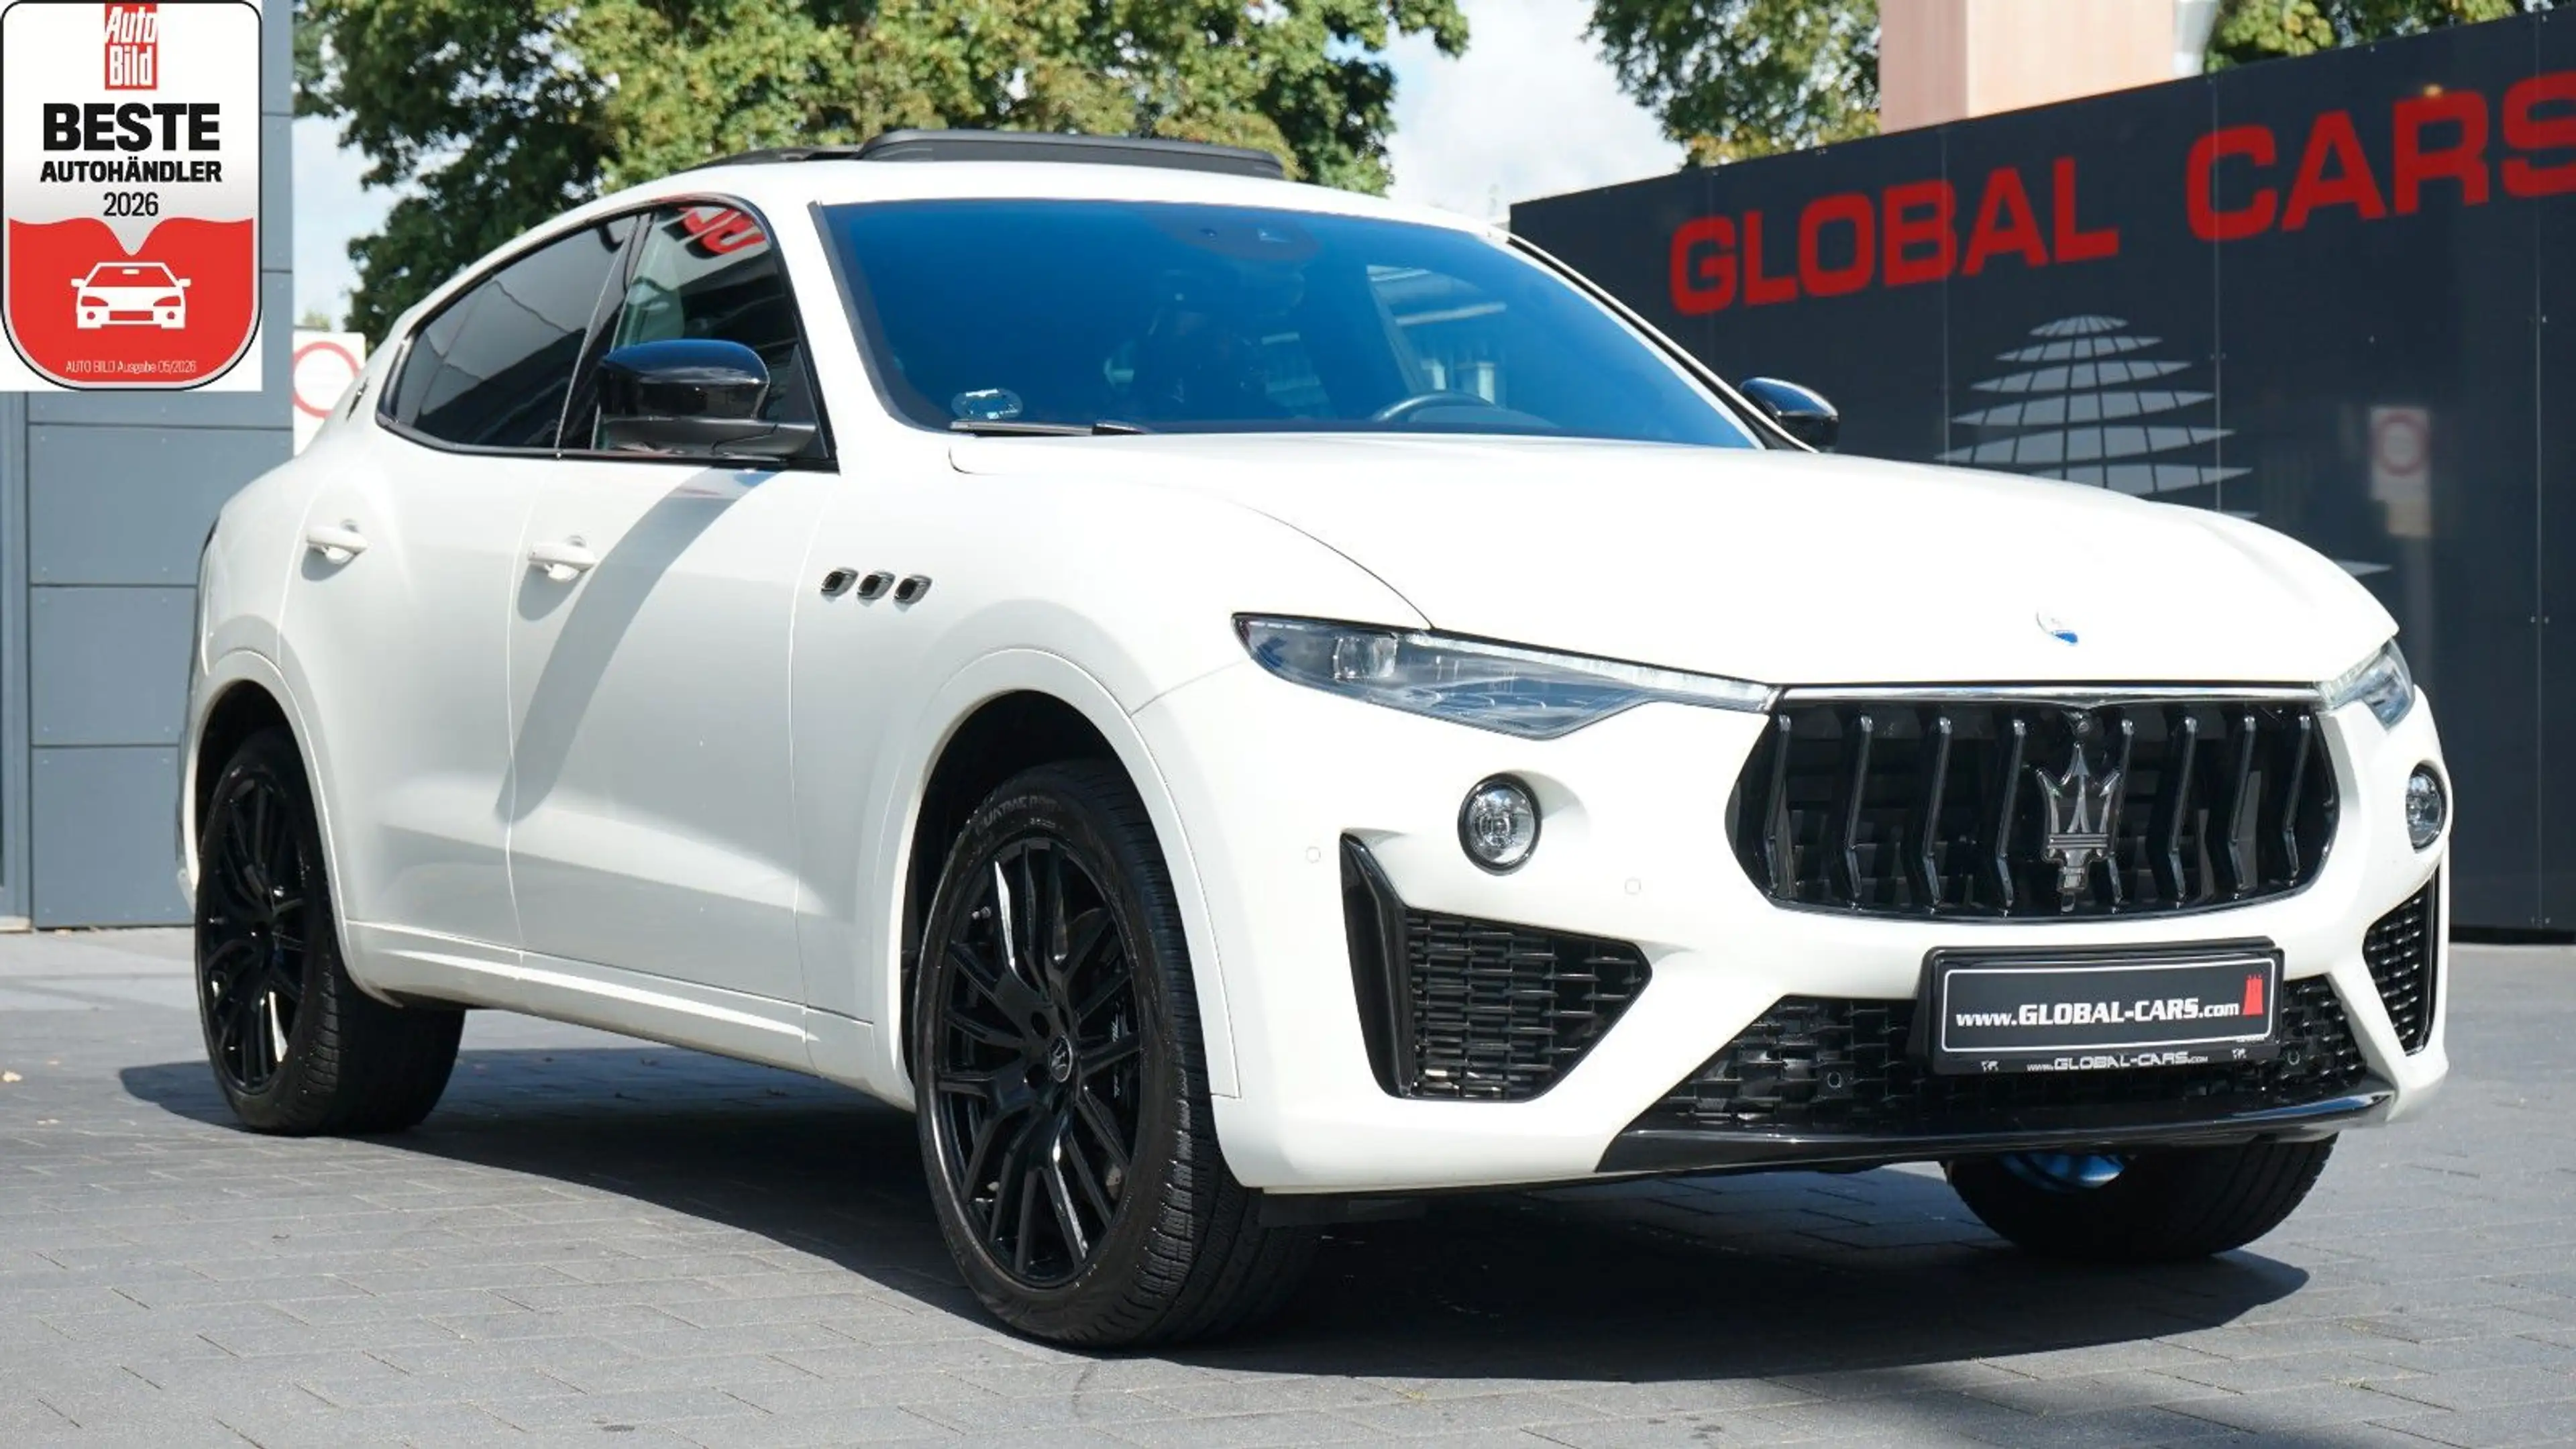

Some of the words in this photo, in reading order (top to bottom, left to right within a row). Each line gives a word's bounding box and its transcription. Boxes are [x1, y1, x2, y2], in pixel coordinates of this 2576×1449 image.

[1669, 157, 2120, 315] GLOBAL
[2185, 70, 2576, 241] CARS
[1955, 997, 2240, 1026] www.GLOBAL-CARS.com
